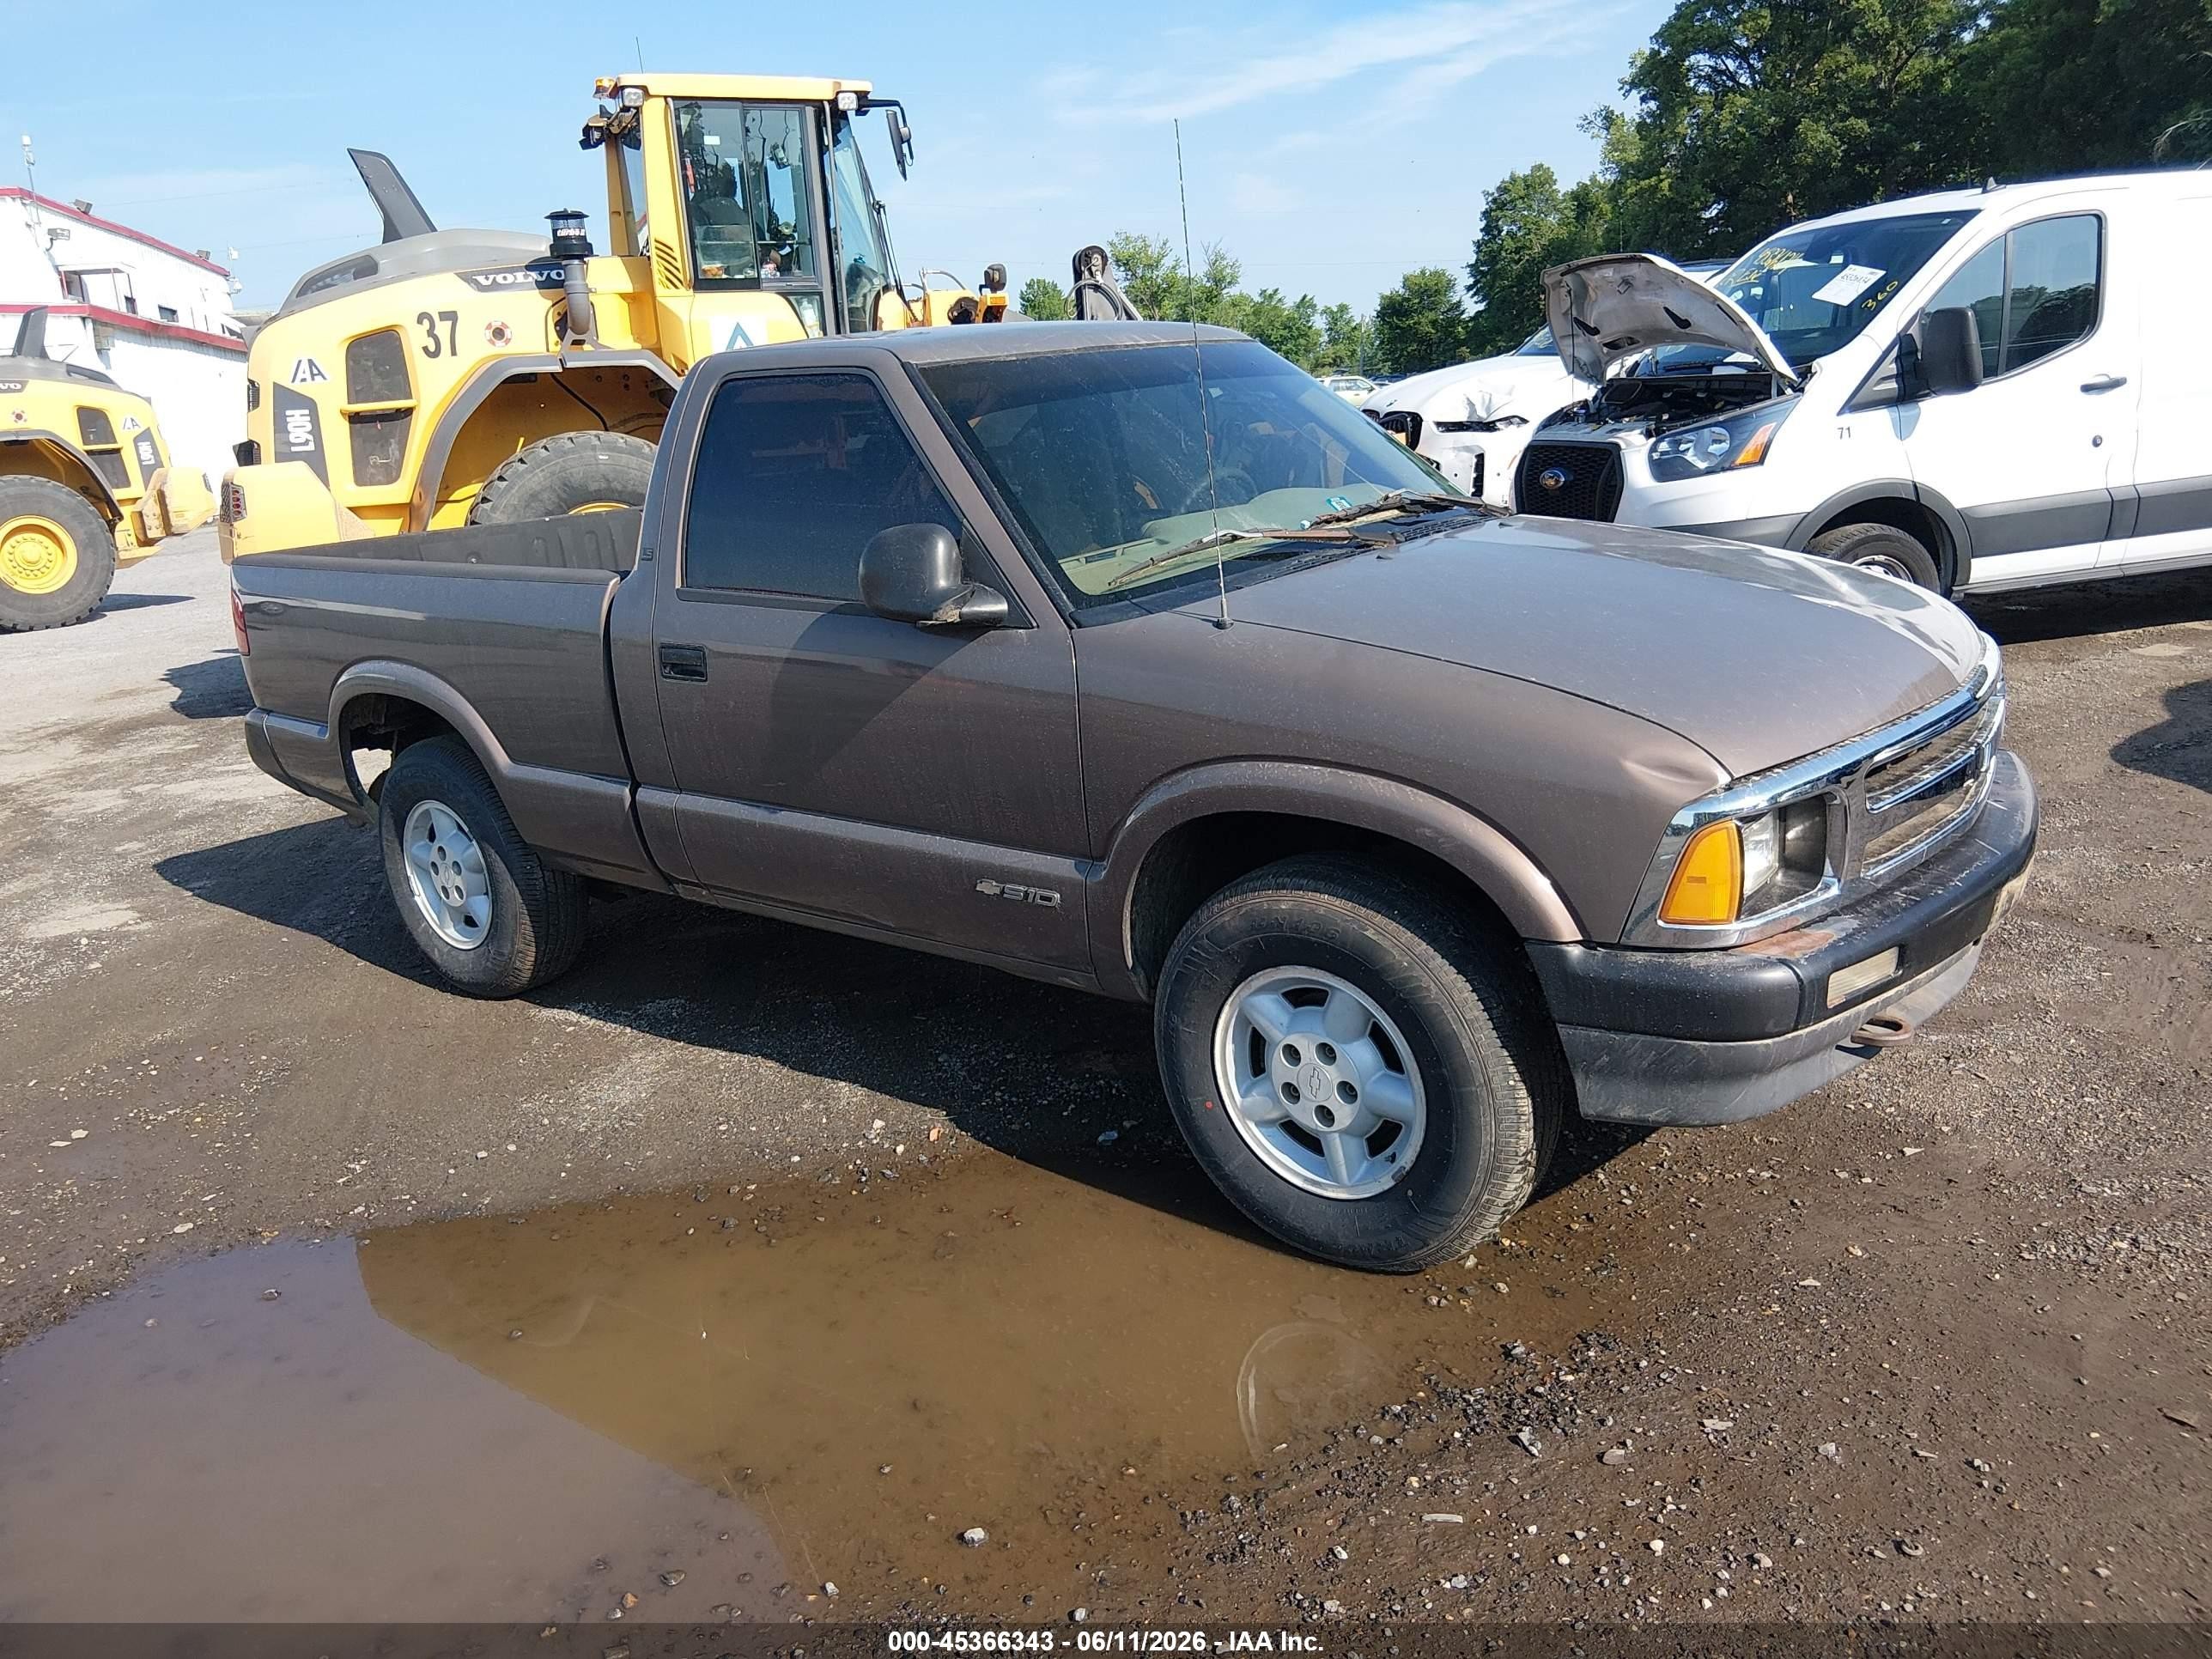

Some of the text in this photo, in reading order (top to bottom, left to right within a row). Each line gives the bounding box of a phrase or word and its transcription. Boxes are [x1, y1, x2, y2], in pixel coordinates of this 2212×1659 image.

[471, 269, 564, 286] VOLVO
[1861, 281, 1898, 311] 360
[416, 310, 458, 358] 37
[285, 409, 315, 452] L90H
[1837, 426, 1850, 440] 71
[1002, 883, 1060, 907] S10
